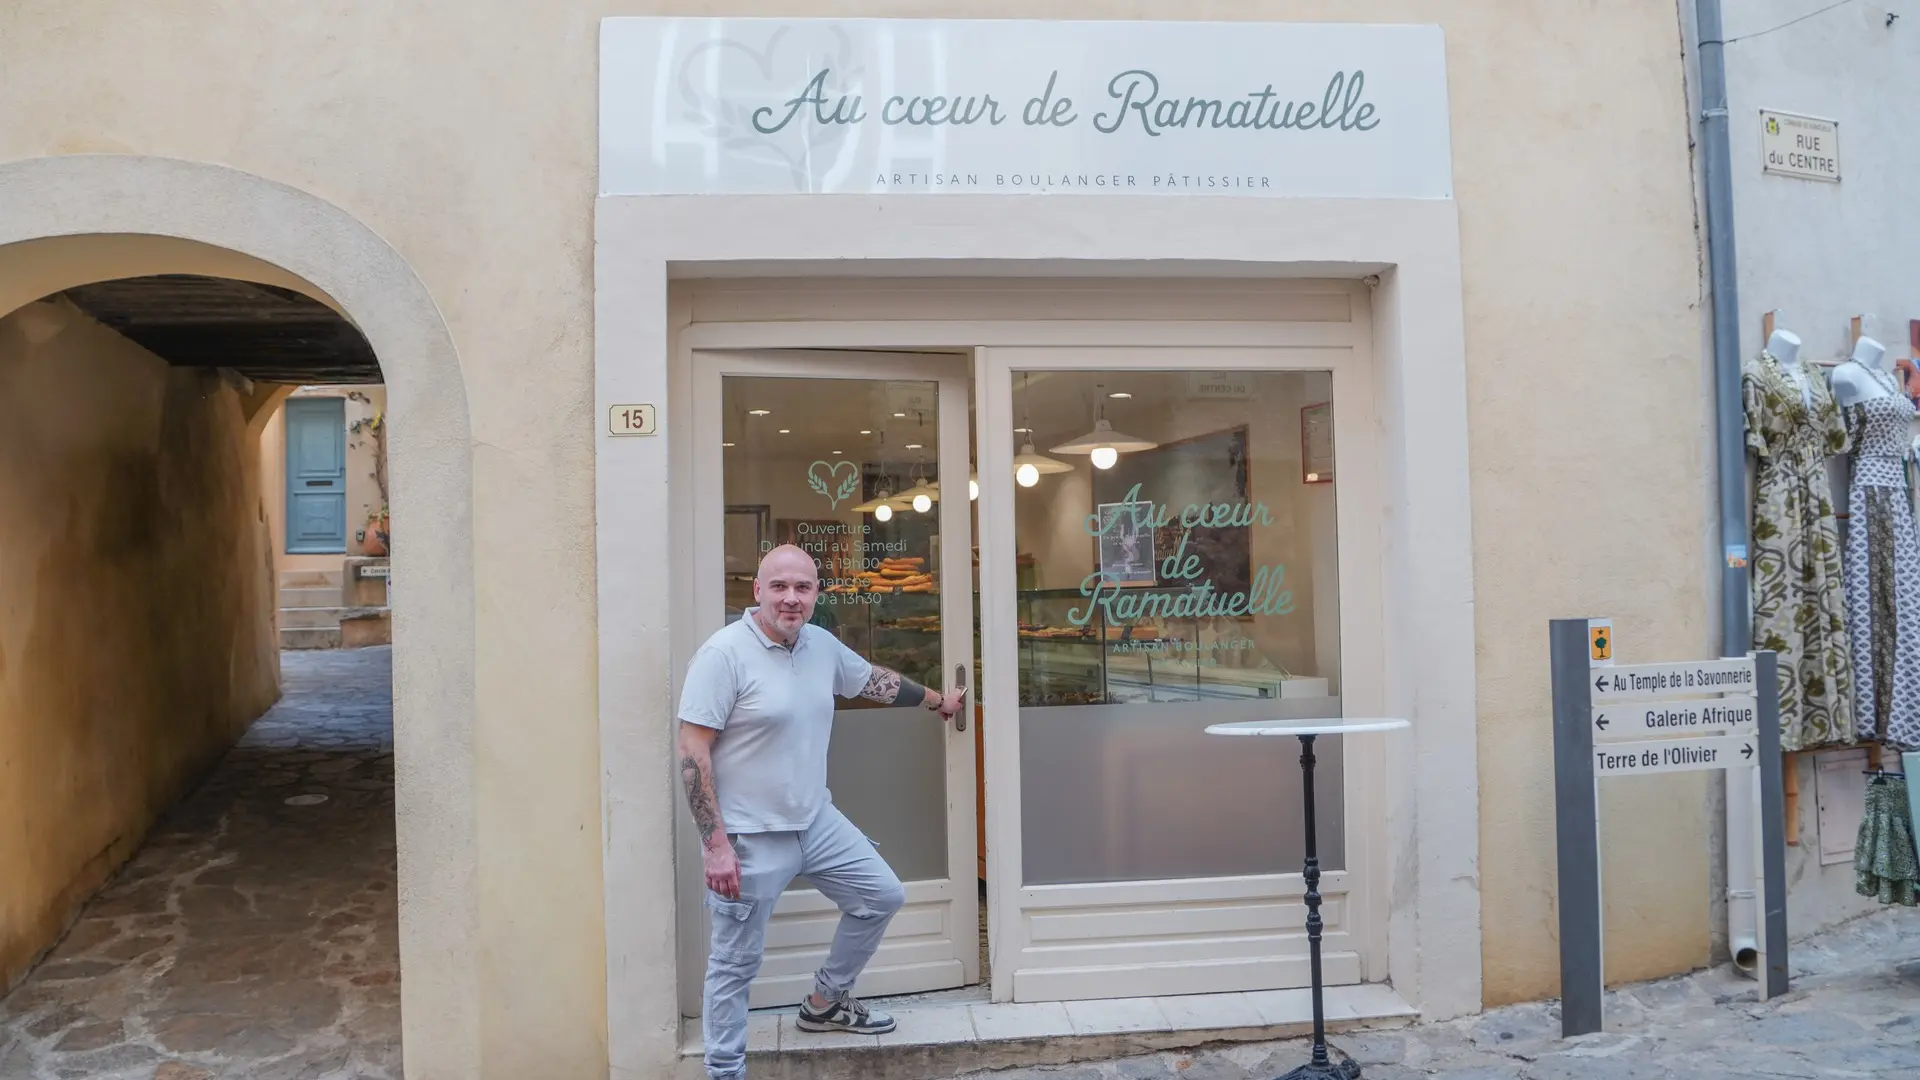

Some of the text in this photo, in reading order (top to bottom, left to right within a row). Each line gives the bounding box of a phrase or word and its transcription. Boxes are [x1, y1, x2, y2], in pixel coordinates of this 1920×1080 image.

[752, 68, 1380, 137] Au cœur de Ramatuelle
[1796, 134, 1821, 151] RUE
[1769, 150, 1834, 173] du CENTRE
[876, 173, 1271, 188] ARTISAN BOULANGER PÂTISSIER
[622, 409, 643, 429] 15
[1083, 483, 1275, 536] Au cœur
[797, 522, 871, 535] Ouverture
[831, 542, 850, 552] au
[853, 540, 907, 552] Samedi
[1161, 529, 1204, 579] de
[825, 557, 833, 569] à
[838, 557, 880, 569] 19h00
[829, 593, 838, 605] à
[841, 592, 882, 605] 13h30
[1067, 564, 1297, 626] Ramatuelle
[1112, 638, 1256, 653] ARTISAN BOULANGER
[1613, 667, 1752, 693] Au Temple de la Savonnerie
[1646, 706, 1752, 728] Galerie Afrique
[1597, 746, 1717, 770] Terre de l'Olivier
